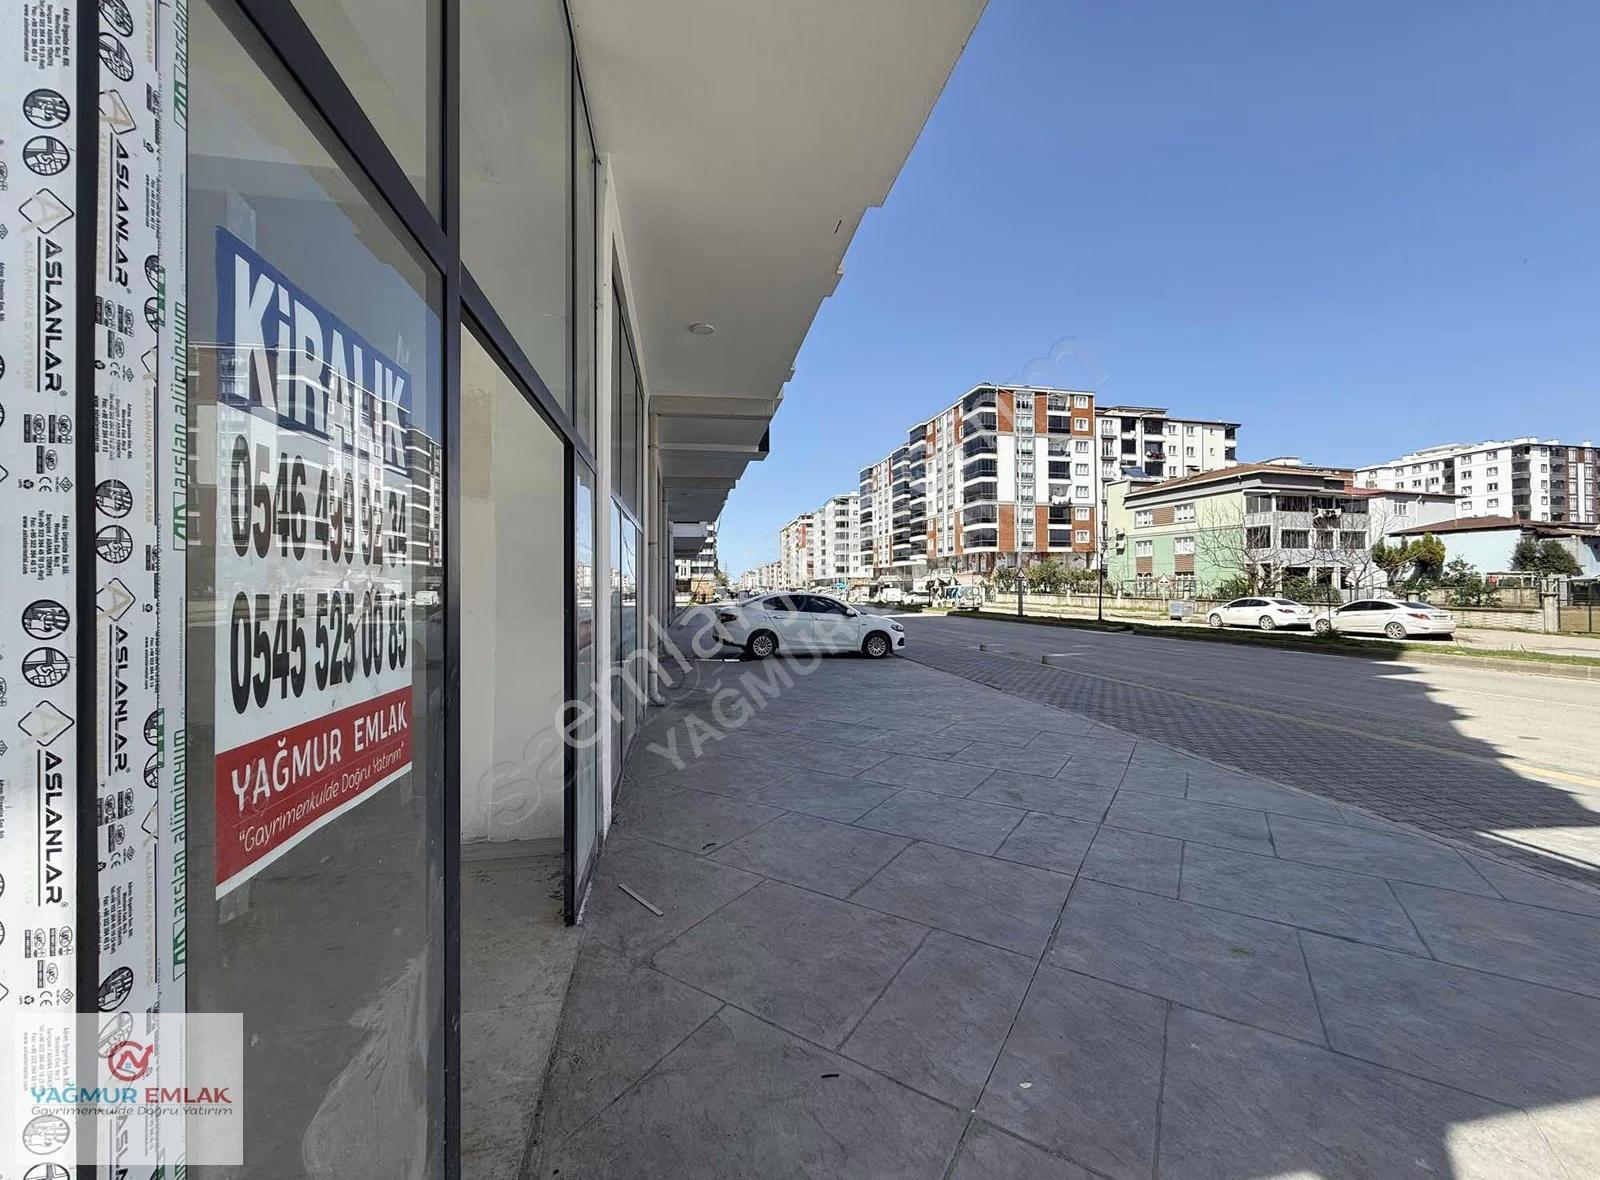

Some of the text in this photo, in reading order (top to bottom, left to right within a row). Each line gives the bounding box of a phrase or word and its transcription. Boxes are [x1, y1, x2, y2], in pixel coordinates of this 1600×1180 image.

[45, 238, 63, 391] ASLANLAR
[230, 434, 307, 561] 0546
[115, 625, 128, 773] ASLANLAR
[230, 591, 306, 714] 0545
[315, 590, 355, 691] 525
[361, 590, 383, 678] 00
[388, 591, 406, 671] 85
[231, 701, 408, 812] YAĞMUR EMLAK
[45, 750, 63, 904] ASLANLAR
